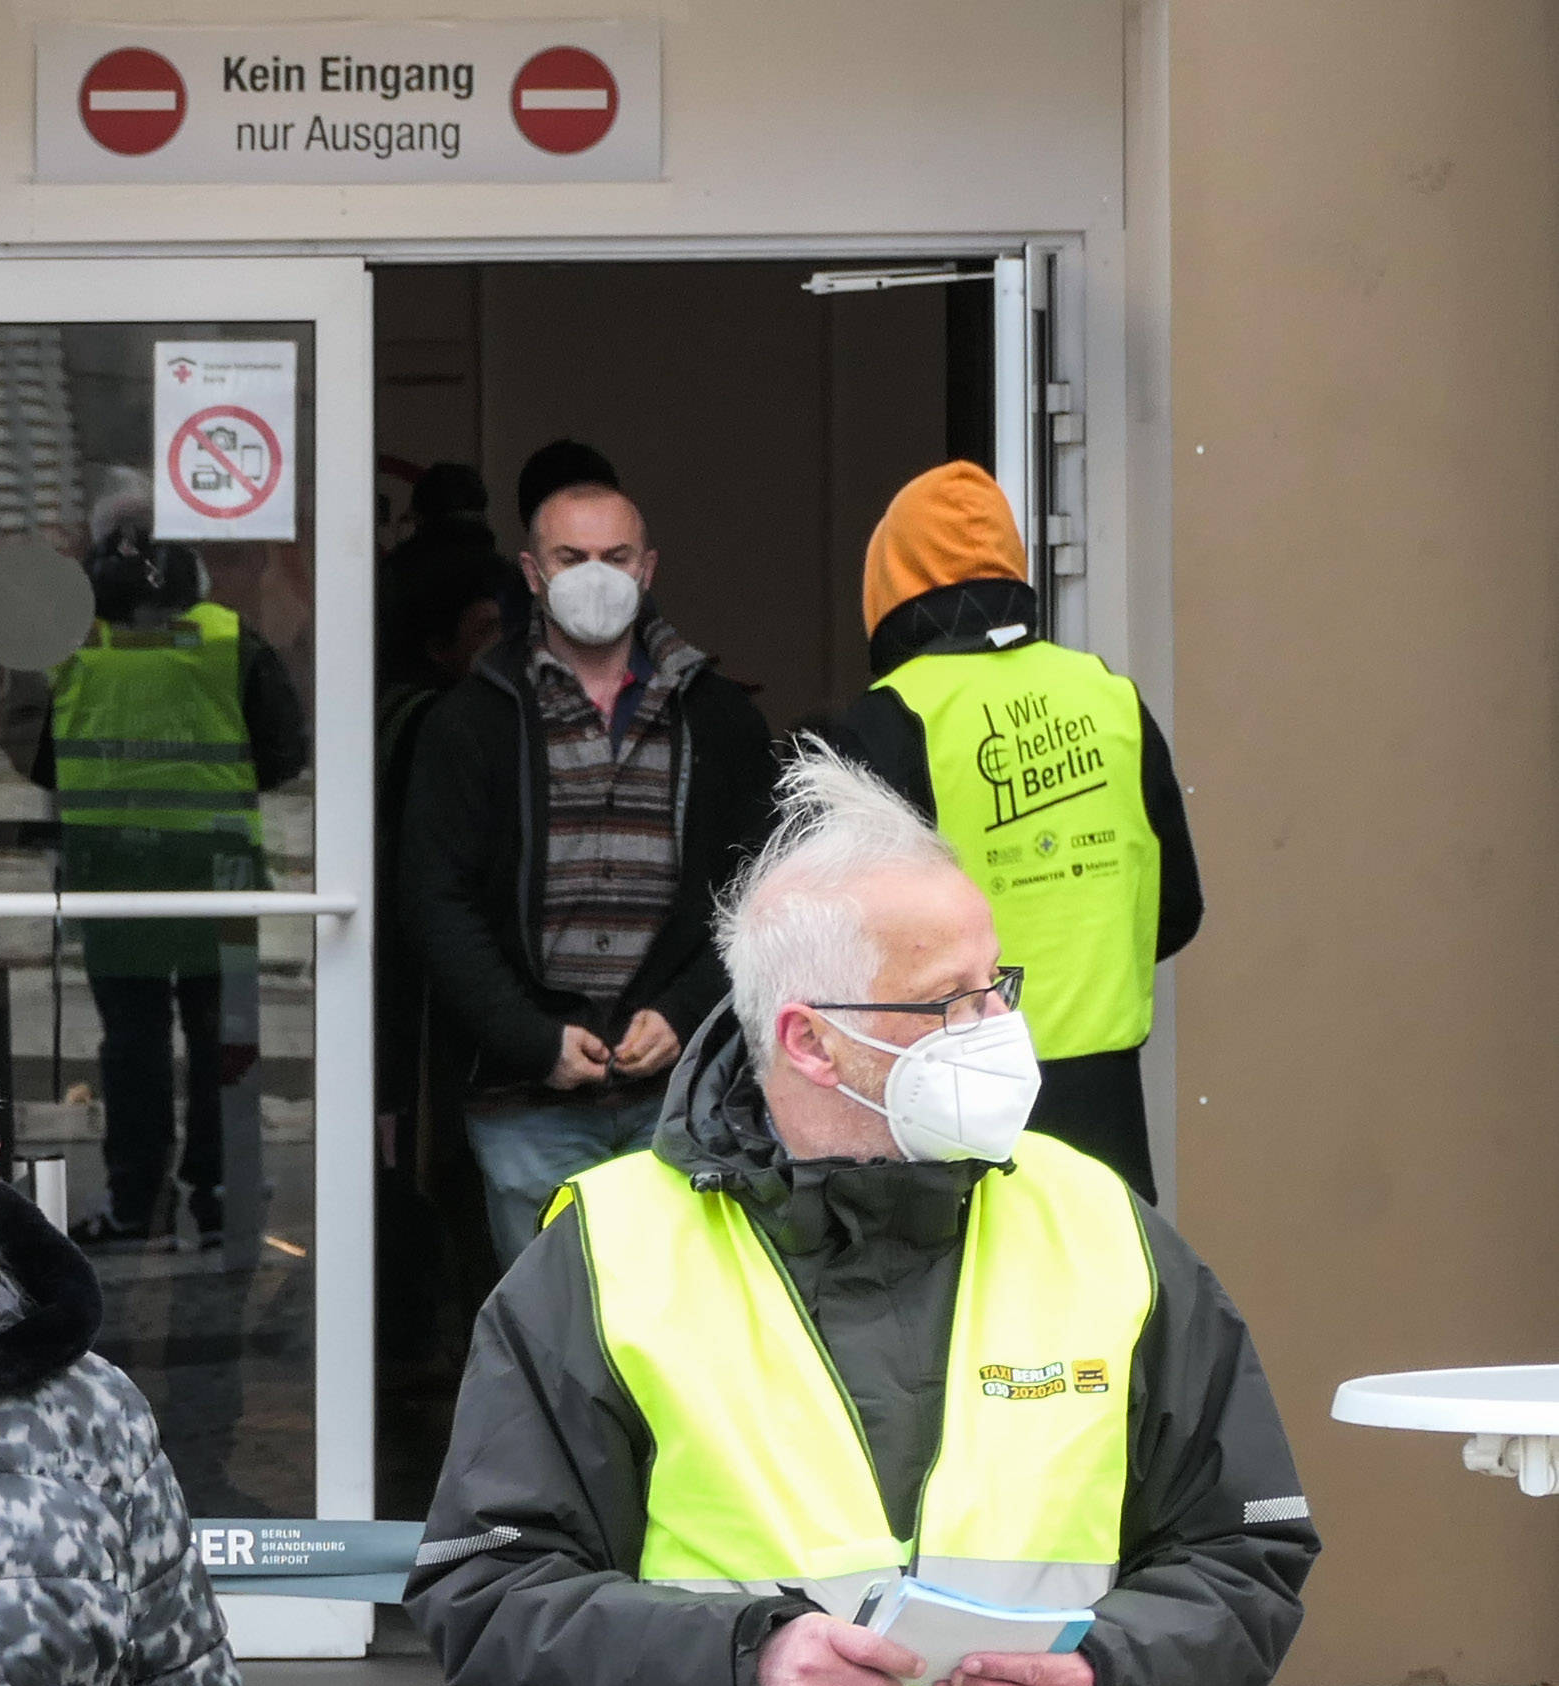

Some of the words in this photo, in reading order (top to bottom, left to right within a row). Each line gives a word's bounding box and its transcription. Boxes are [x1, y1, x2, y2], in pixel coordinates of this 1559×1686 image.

[223, 57, 306, 93] Kein
[321, 57, 475, 99] Eingang
[237, 119, 296, 151] nur
[305, 115, 461, 159] Ausgang
[1005, 691, 1049, 729] Wir
[1015, 711, 1097, 764] helfen
[1023, 745, 1105, 797] Berlin
[1010, 1380, 1064, 1399] 202020
[192, 1528, 255, 1565] ER
[261, 1529, 301, 1539] BERLIN
[261, 1541, 346, 1552] BRANDENBURG
[261, 1554, 310, 1565] AIRPORT
